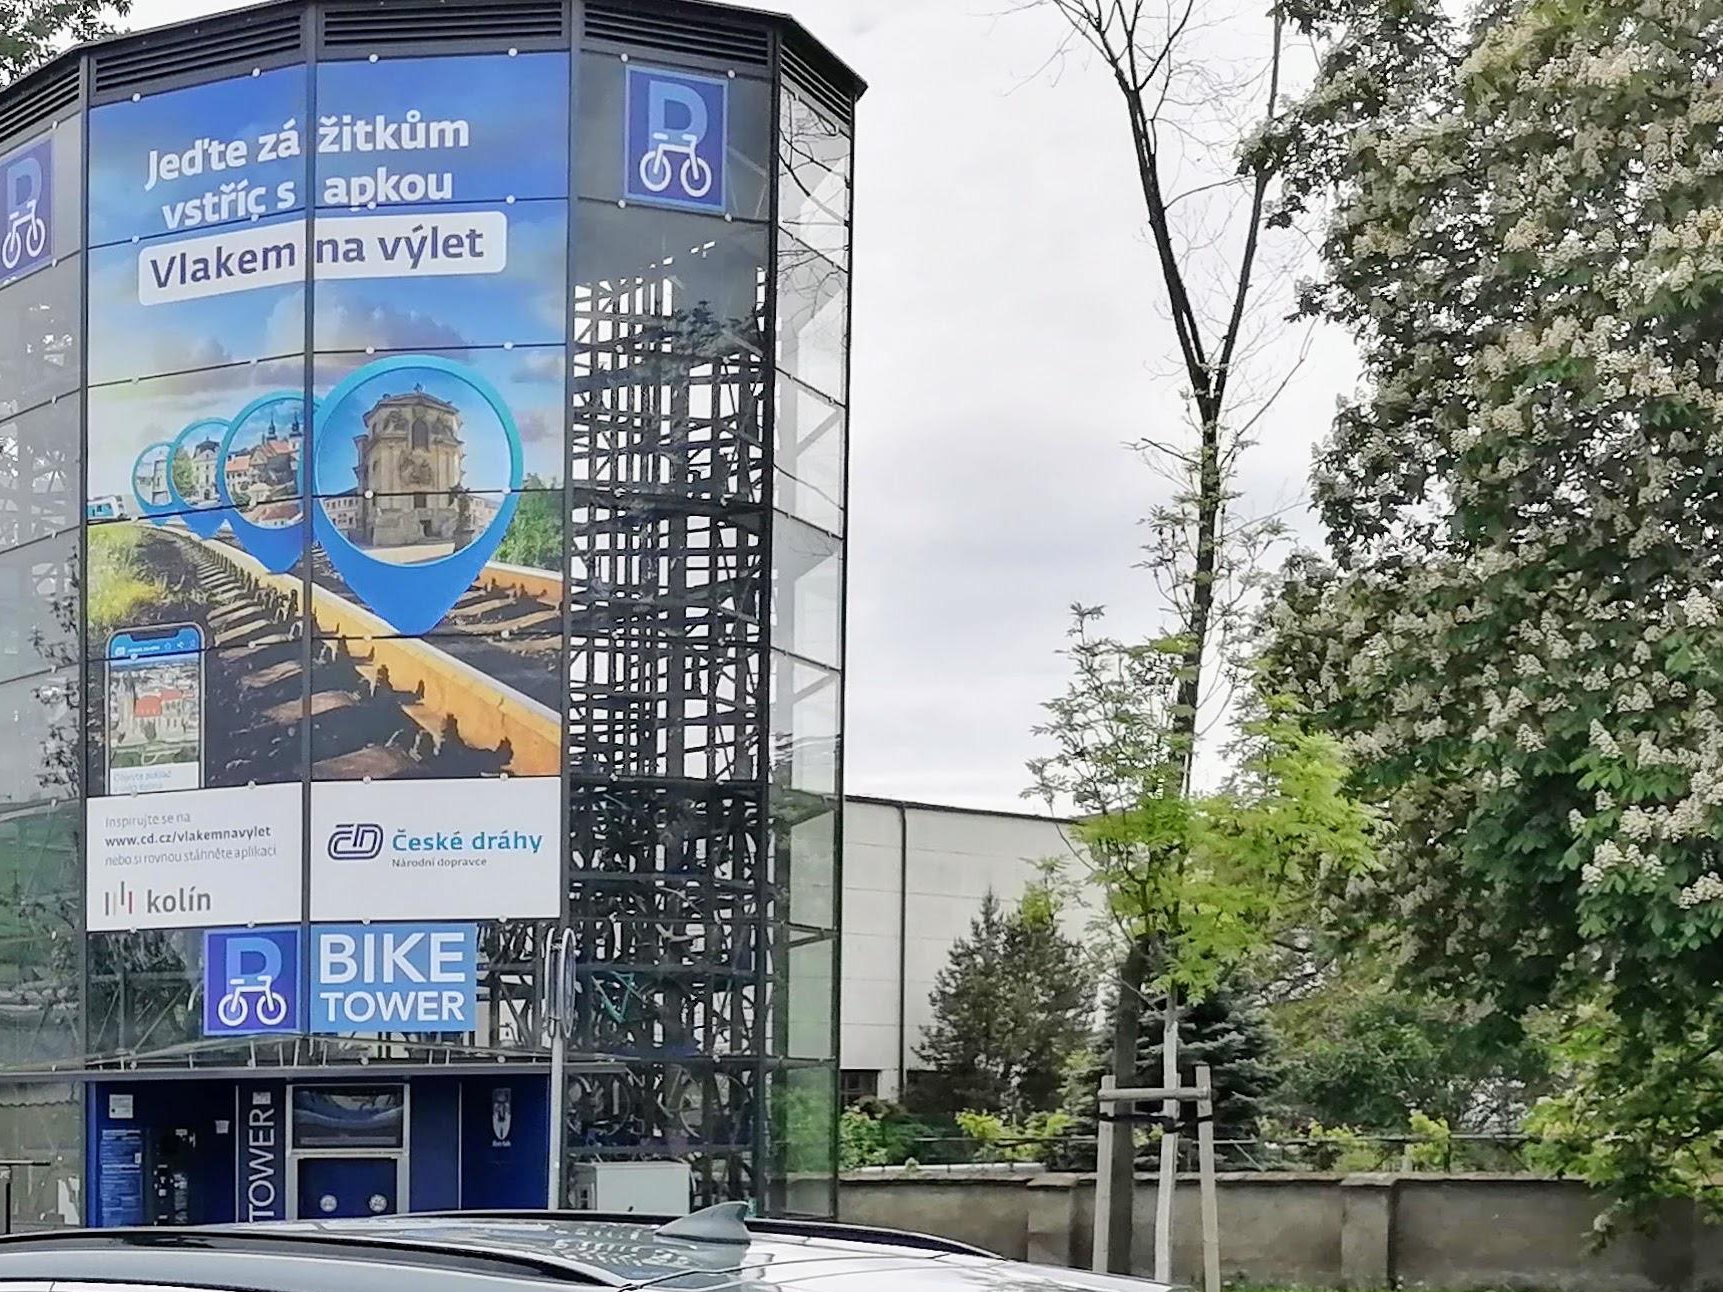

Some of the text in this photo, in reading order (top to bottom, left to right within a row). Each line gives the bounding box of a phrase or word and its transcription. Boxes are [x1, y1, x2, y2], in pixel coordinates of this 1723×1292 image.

[145, 137, 247, 190] Jeďte
[161, 167, 453, 230] vstříc s apkou
[149, 223, 485, 290] Vlakem na výlet
[105, 812, 191, 830] Inspirujte se na
[105, 826, 271, 847] www.cd.cz/vlakemnavylet
[392, 829, 543, 853] České dráhy
[105, 855, 132, 867] nebo
[134, 855, 142, 866] si
[144, 852, 182, 865] rovnou
[184, 847, 233, 863] stáhněte
[392, 858, 487, 869] Národní dopravce
[147, 886, 212, 914] kolín
[319, 932, 466, 985] BIKE
[320, 991, 465, 1022] TOWER
[248, 1108, 275, 1222] TOWER
